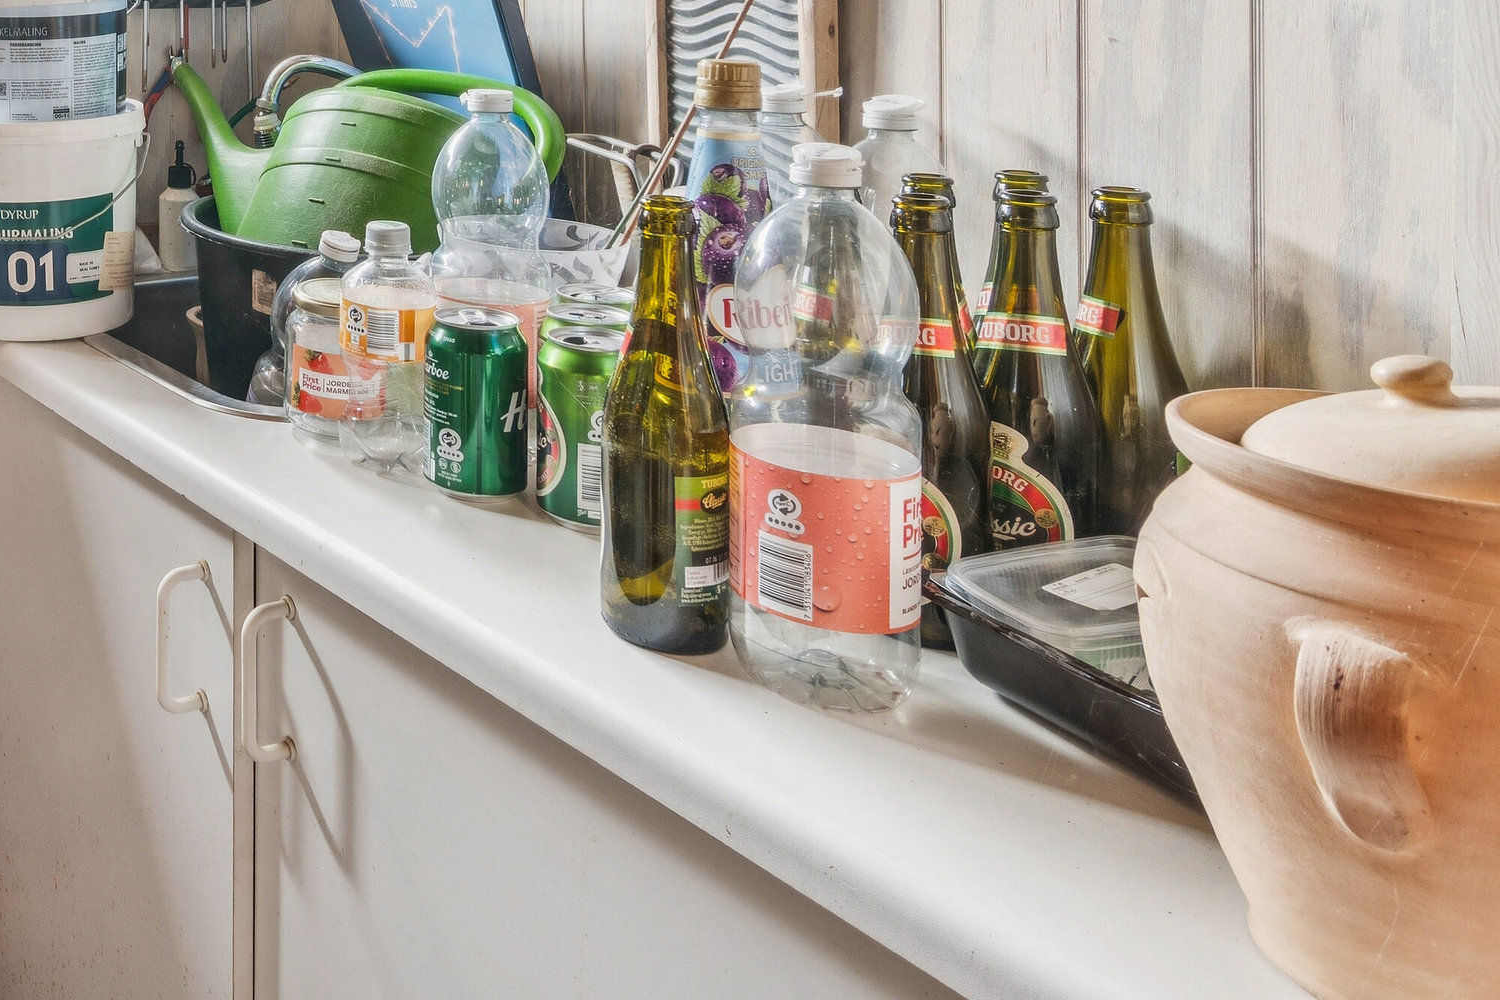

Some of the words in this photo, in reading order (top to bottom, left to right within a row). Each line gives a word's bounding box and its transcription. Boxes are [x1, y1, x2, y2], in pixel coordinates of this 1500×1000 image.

[0, 209, 39, 220] DYRUP
[7, 249, 54, 293] 01
[978, 321, 1050, 344] TUBORG
[302, 373, 319, 385] First
[302, 381, 322, 392] Price
